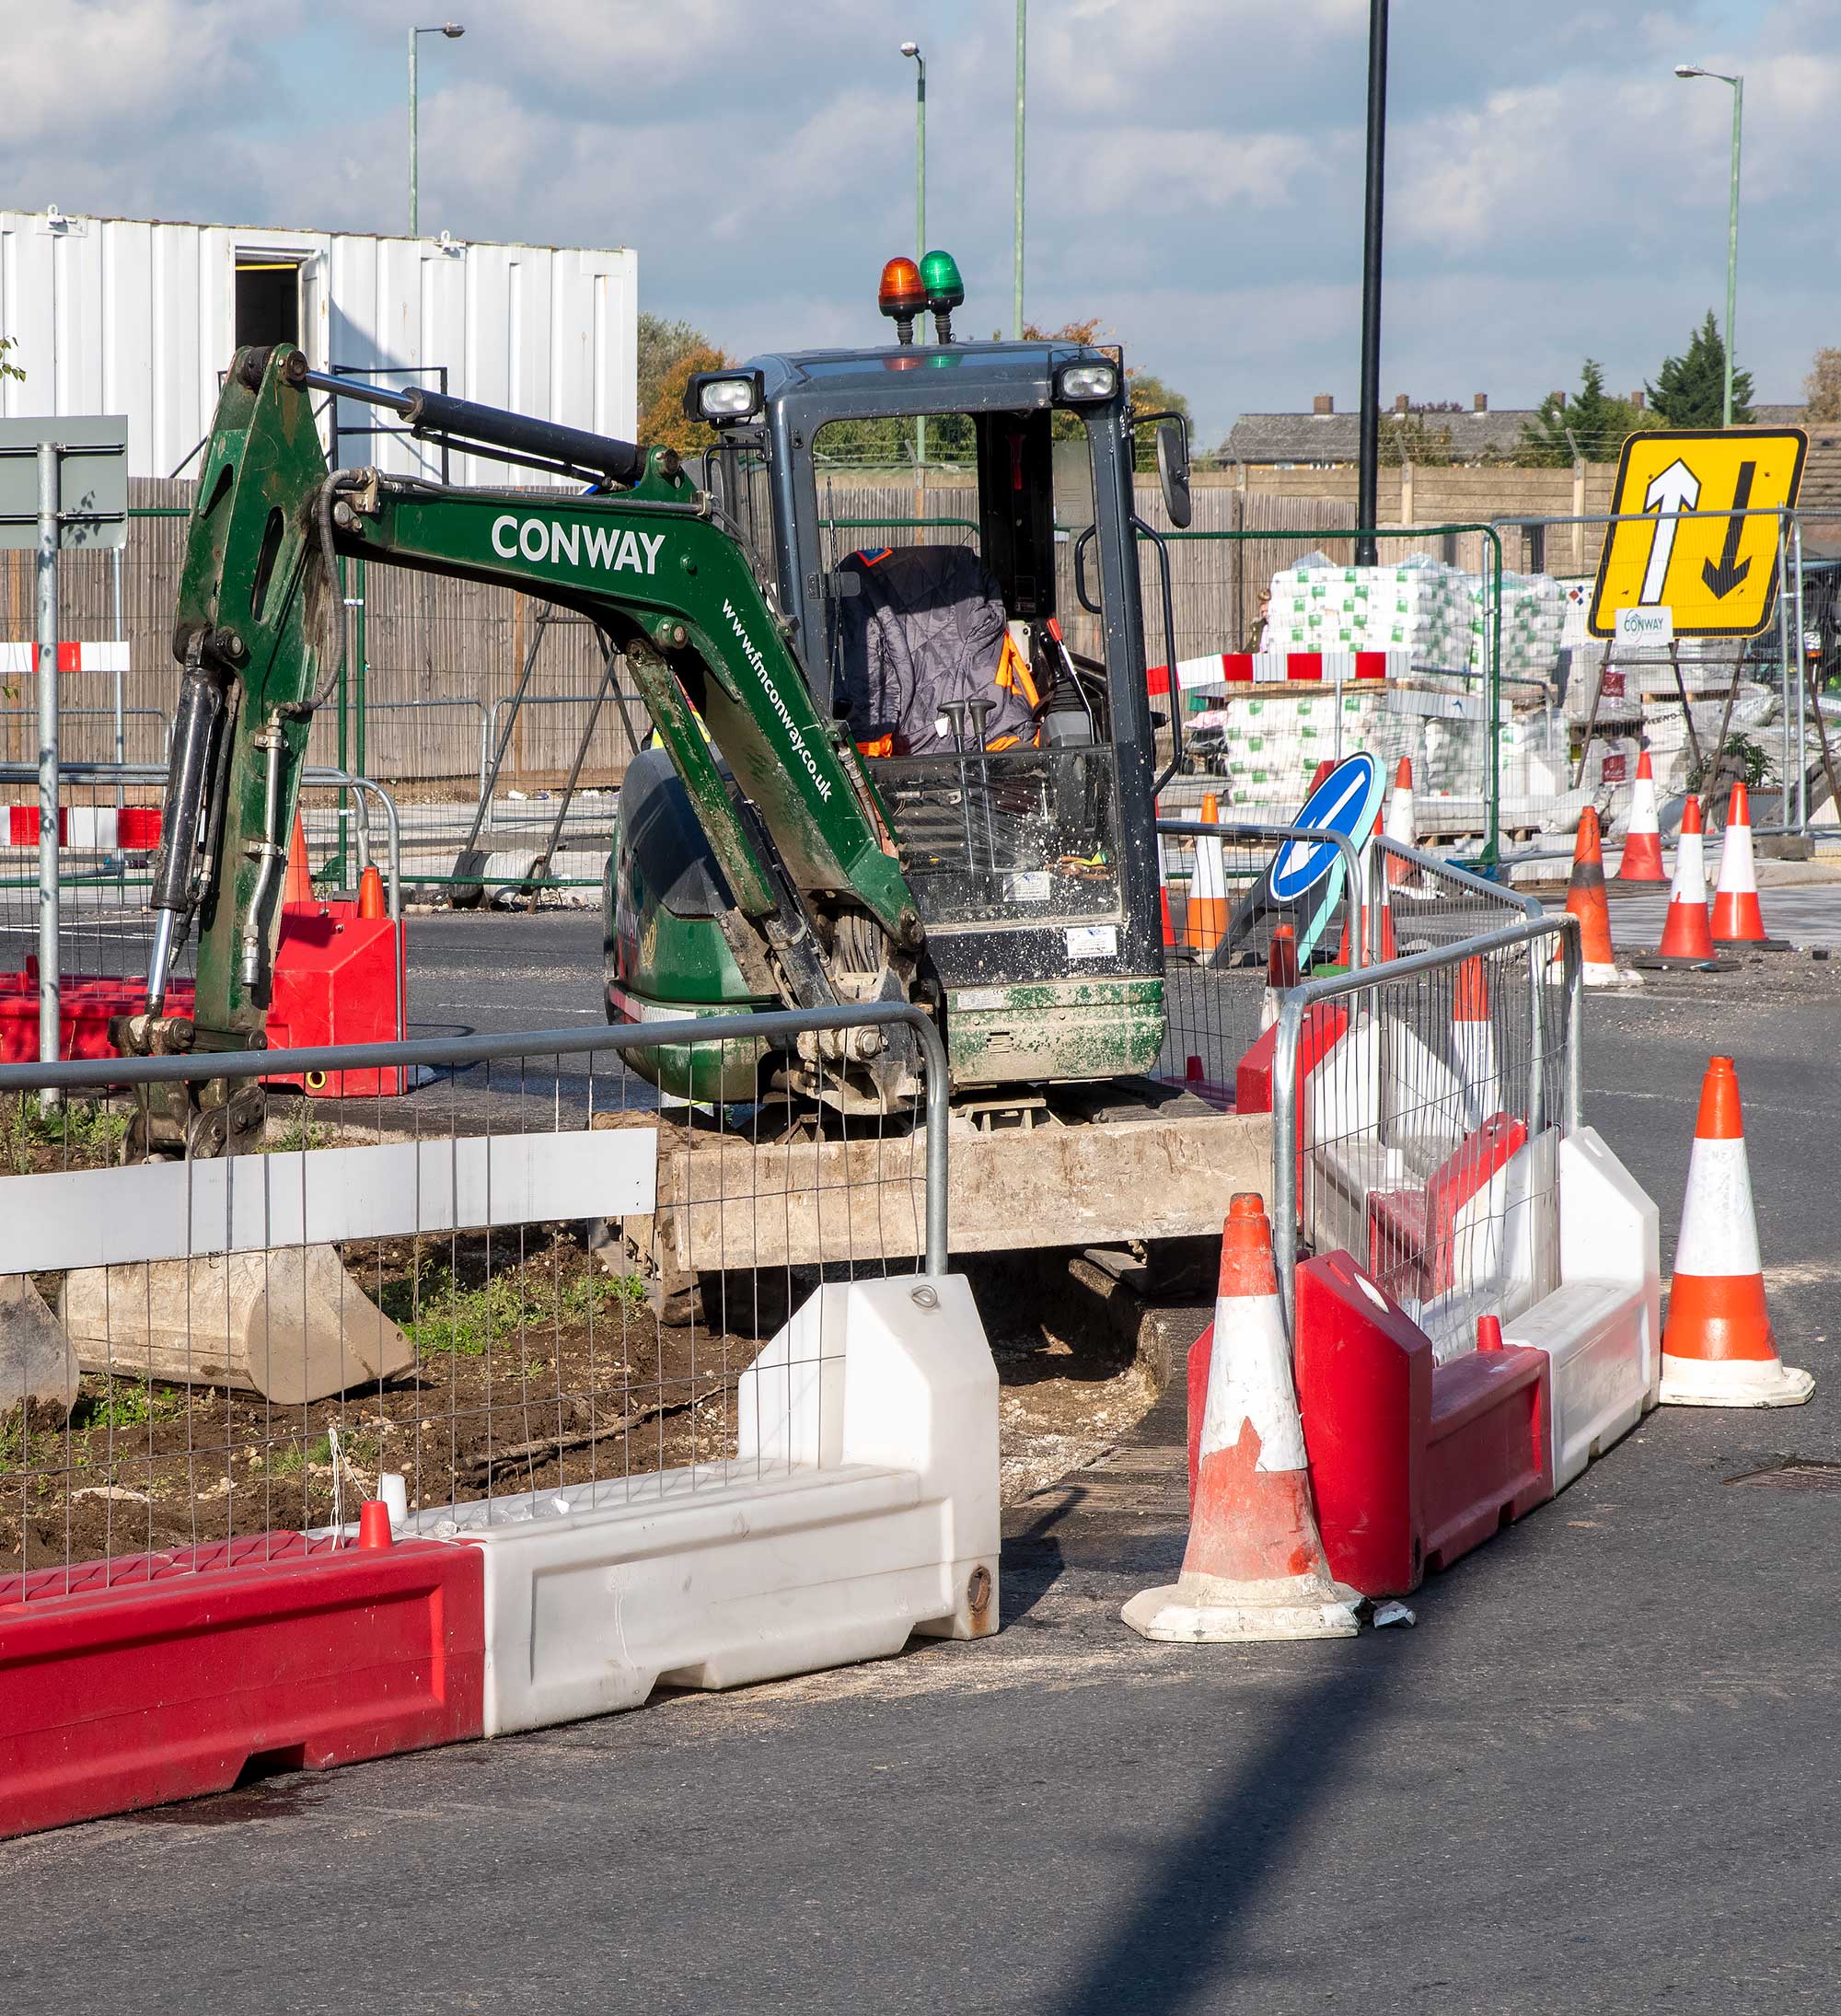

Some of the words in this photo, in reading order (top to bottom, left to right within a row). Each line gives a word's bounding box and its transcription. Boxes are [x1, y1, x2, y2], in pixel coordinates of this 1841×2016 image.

[492, 515, 666, 574] CONWAY
[1624, 618, 1663, 632] CONWAY
[722, 597, 832, 804] www.fmconway.co.uk
